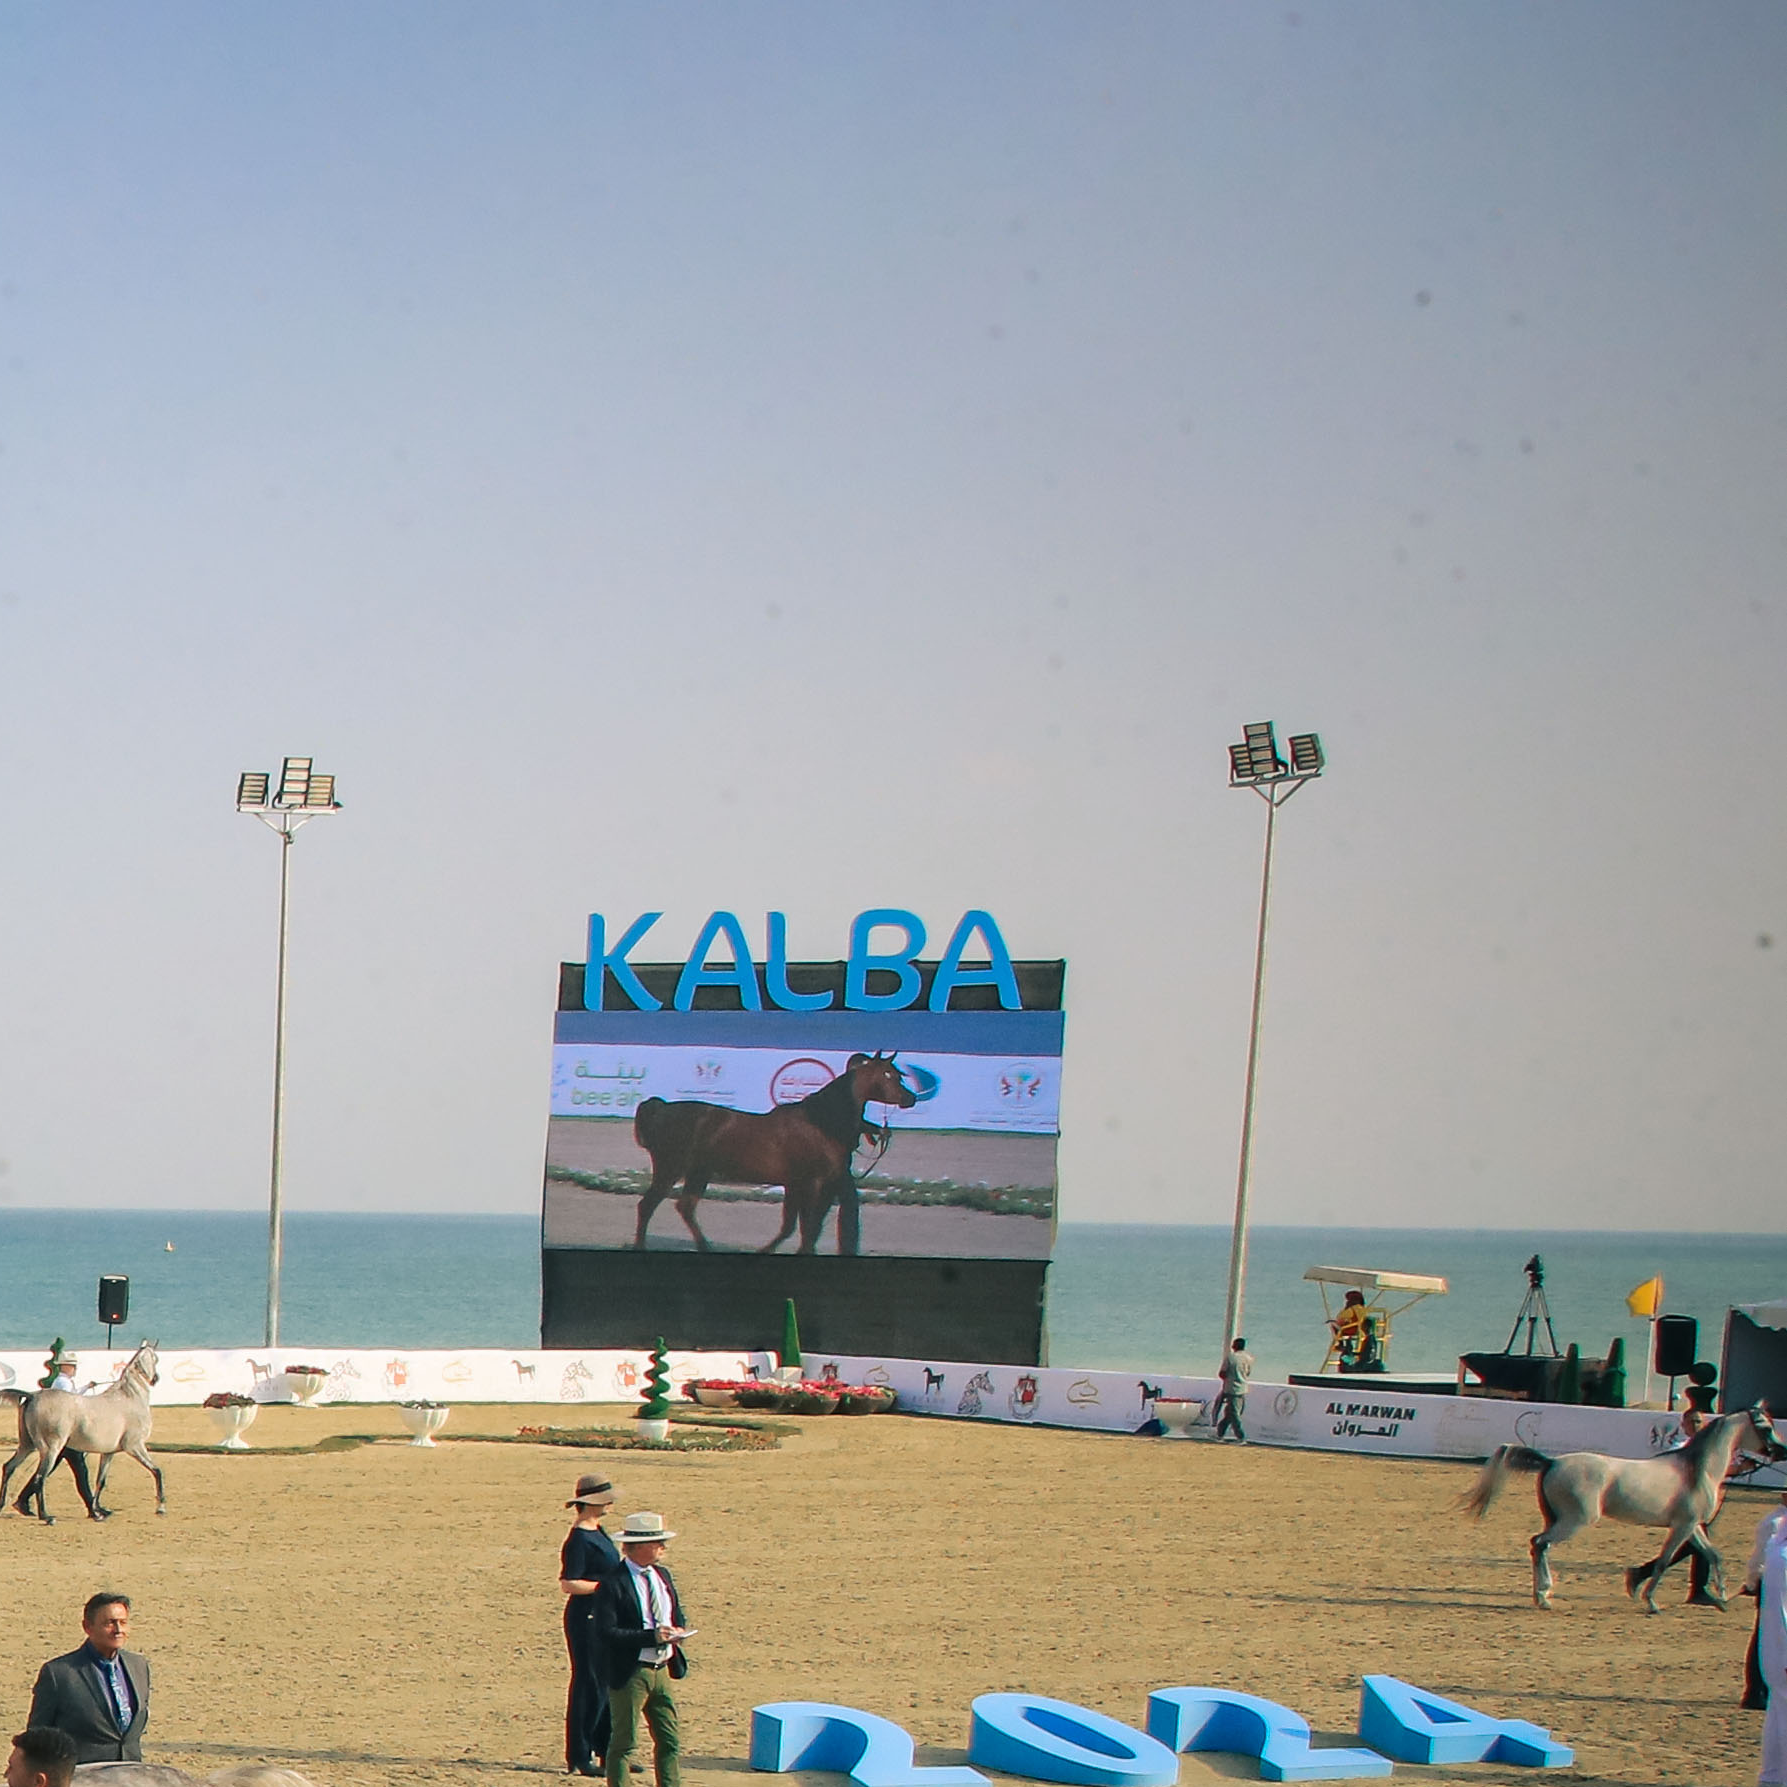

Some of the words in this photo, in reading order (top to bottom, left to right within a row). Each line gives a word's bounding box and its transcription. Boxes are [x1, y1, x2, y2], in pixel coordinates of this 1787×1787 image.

[583, 908, 1024, 1013] KALBA
[1325, 1402, 1343, 1415] AL
[1345, 1403, 1416, 1421] MARWAN
[1331, 1420, 1400, 1438] المروان
